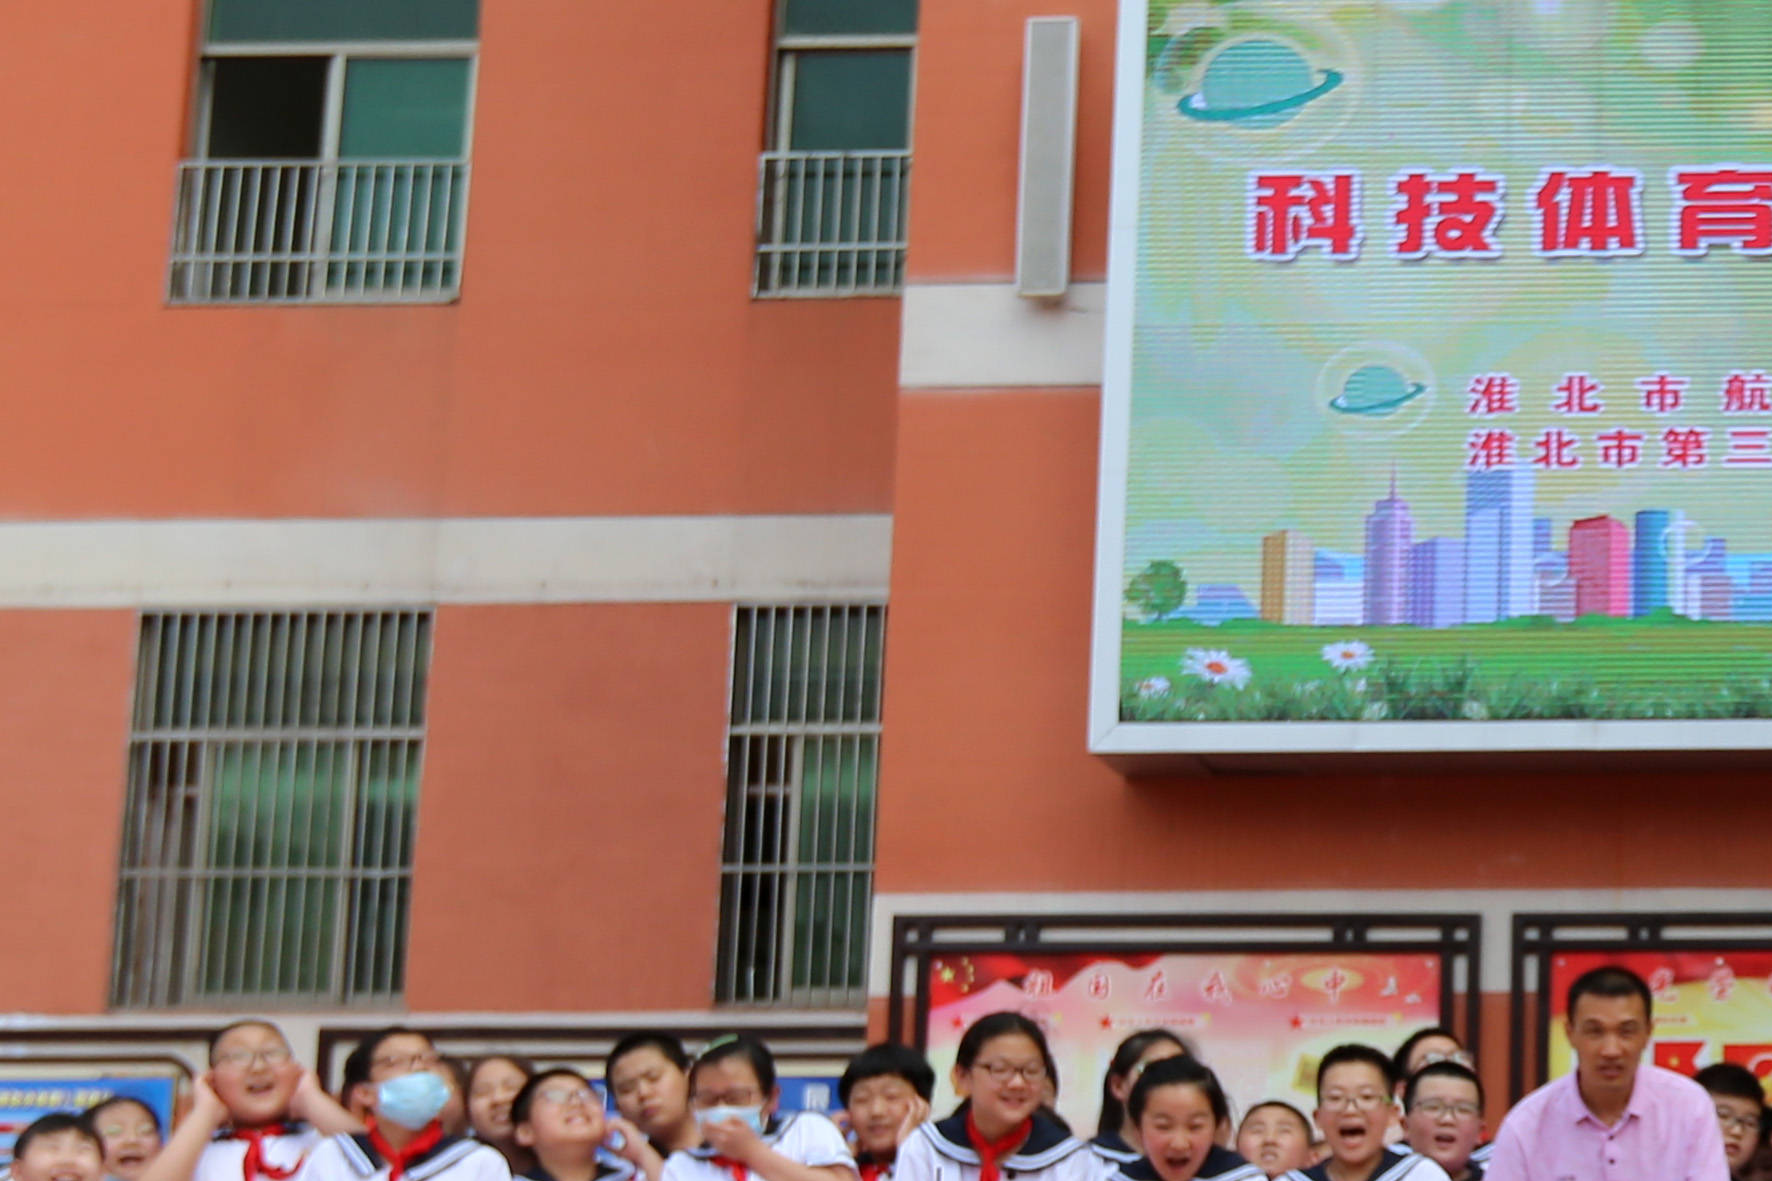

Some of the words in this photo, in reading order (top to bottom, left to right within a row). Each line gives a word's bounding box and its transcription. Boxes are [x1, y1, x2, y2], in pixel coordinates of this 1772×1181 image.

[1023, 967, 1346, 1004] 祖国在我心中
